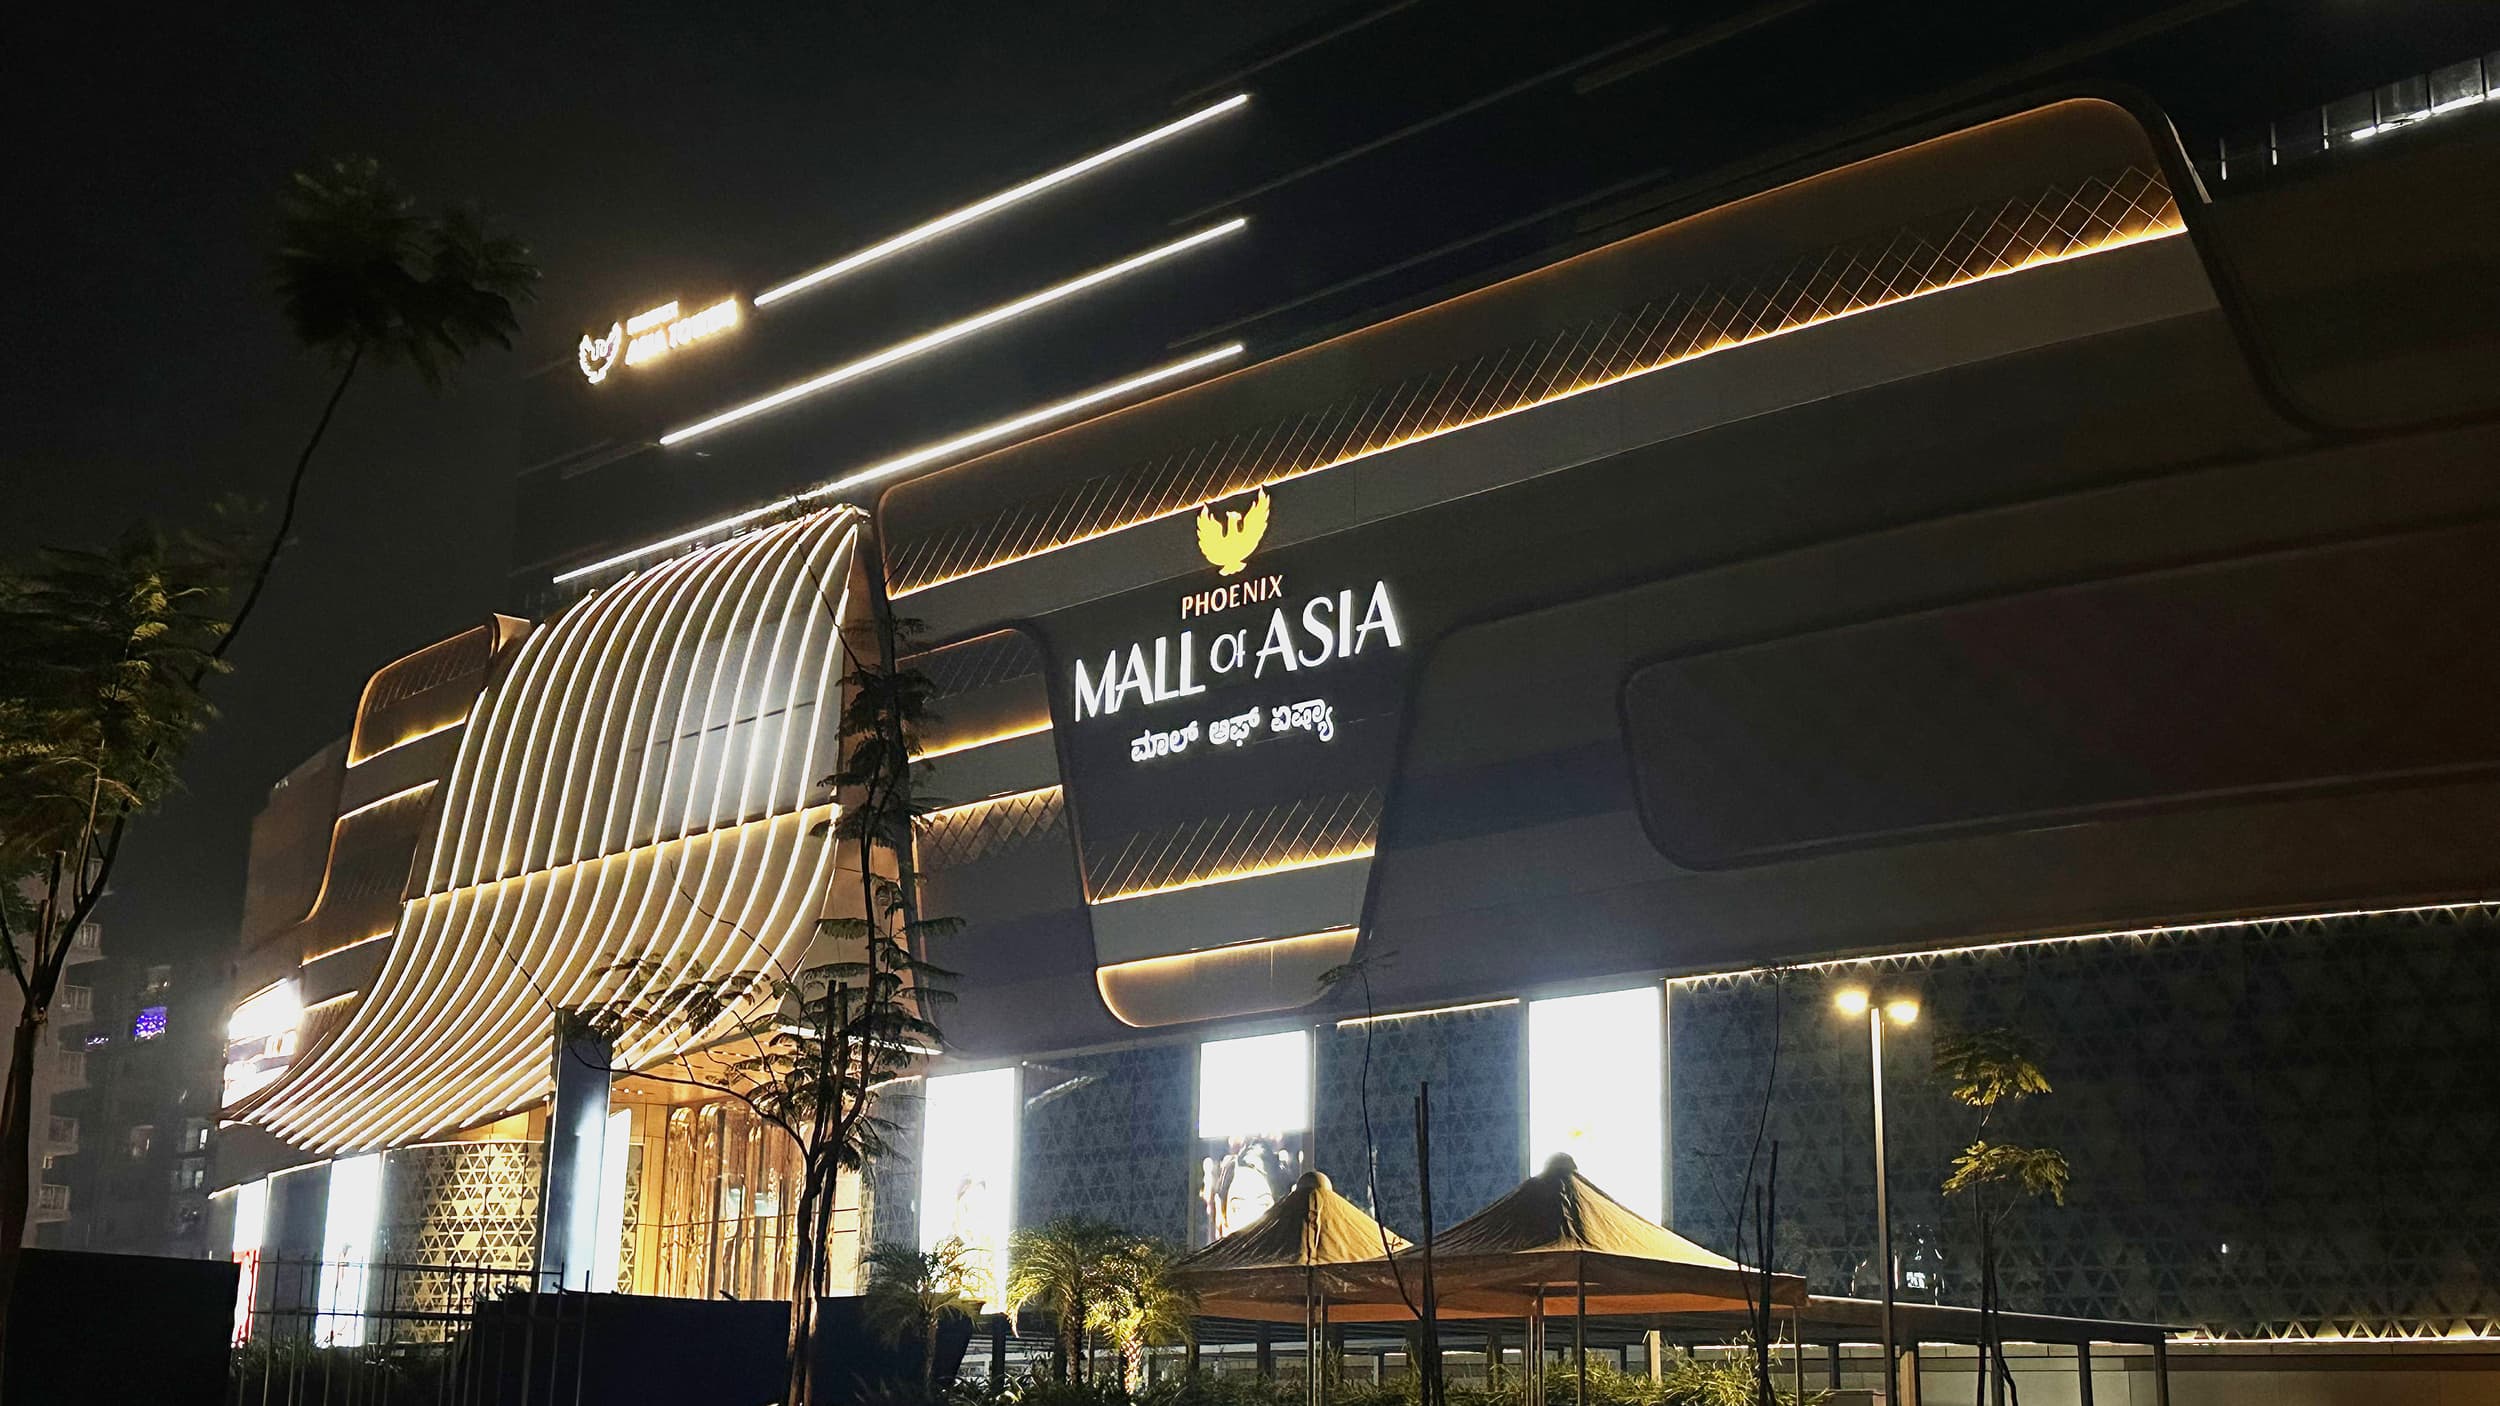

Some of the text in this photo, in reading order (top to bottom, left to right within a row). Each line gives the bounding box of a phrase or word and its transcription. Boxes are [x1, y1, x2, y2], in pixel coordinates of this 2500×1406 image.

[1181, 574, 1284, 620] PHOENIX
[1075, 630, 1206, 723] MALL
[1254, 579, 1403, 680] ASIA
[1130, 720, 1200, 763] ಮಾಲ್
